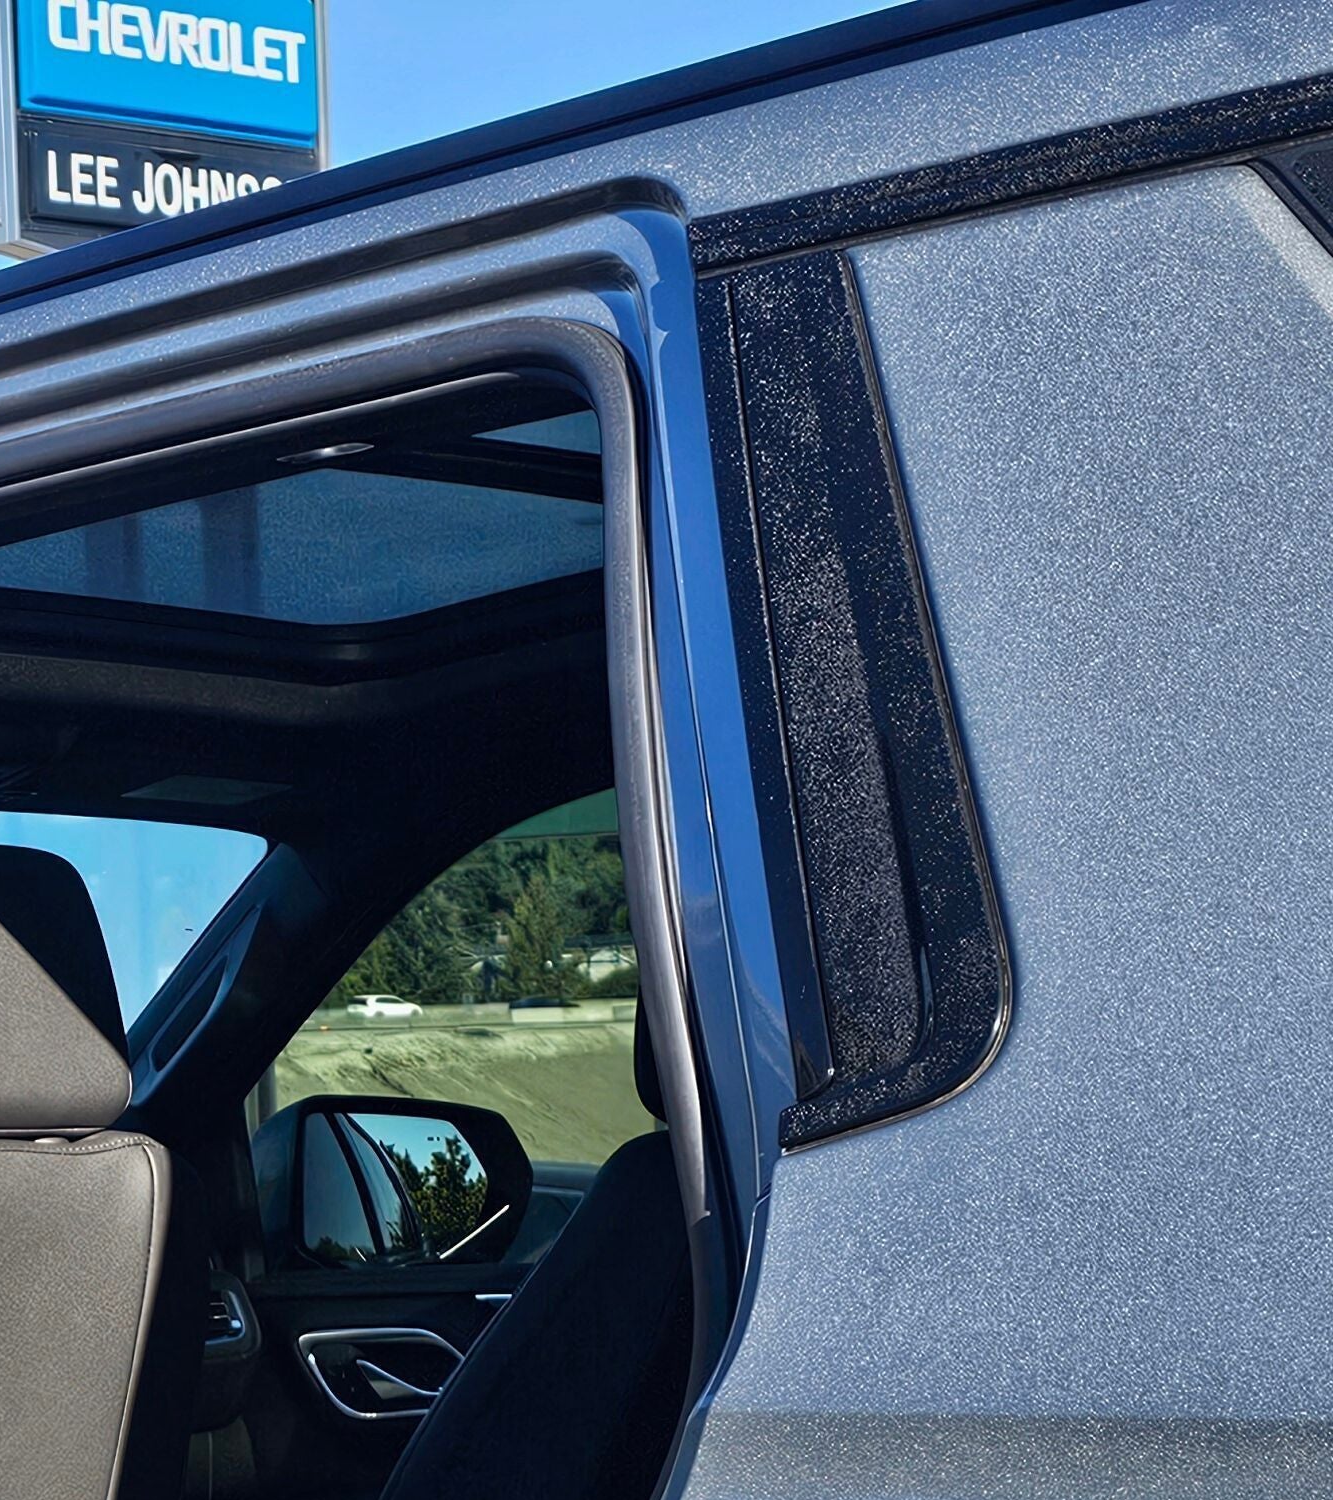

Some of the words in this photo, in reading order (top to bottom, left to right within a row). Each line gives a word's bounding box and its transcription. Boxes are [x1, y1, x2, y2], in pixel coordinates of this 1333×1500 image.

[47, 0, 306, 84] CHEVROLET
[47, 150, 121, 208] LEE
[132, 161, 284, 217] JOHN
